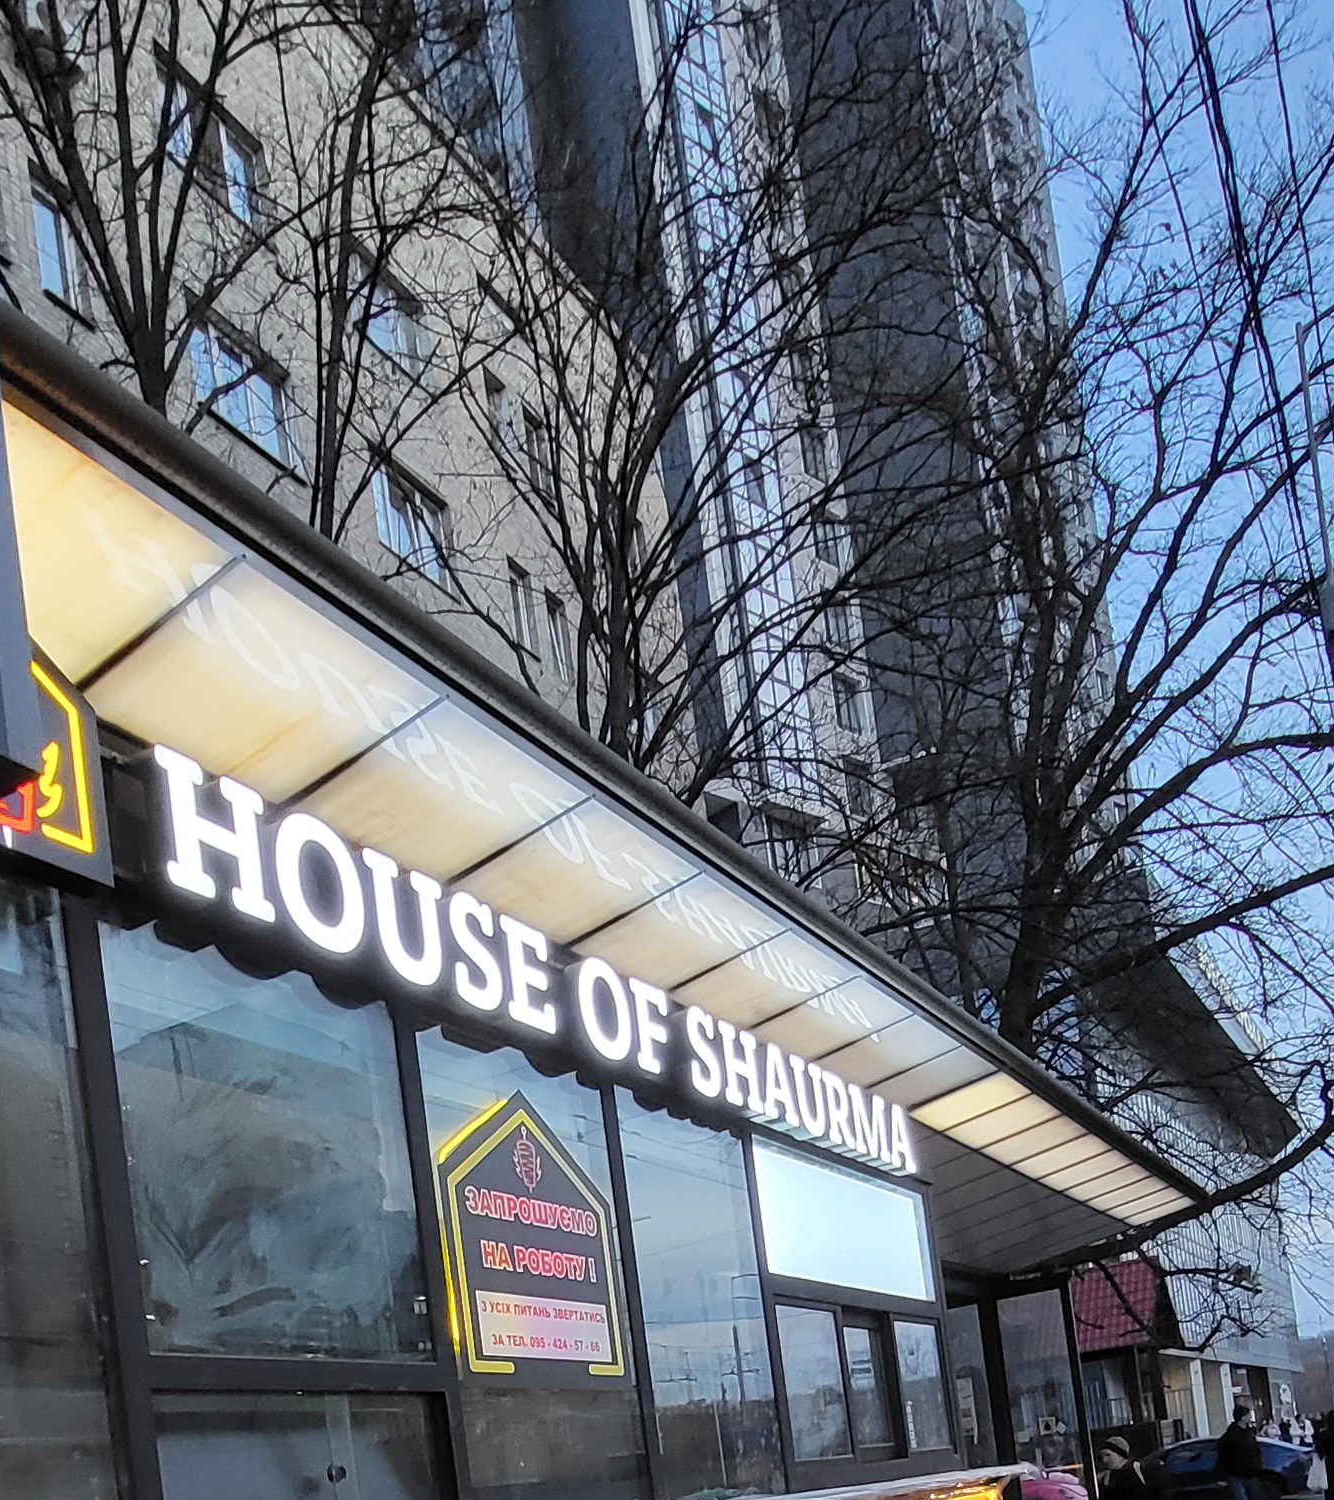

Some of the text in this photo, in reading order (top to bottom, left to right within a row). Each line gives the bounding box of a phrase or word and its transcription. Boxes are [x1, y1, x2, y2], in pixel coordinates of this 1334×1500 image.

[153, 743, 916, 1174] HOUSE OF SHAURMA
[465, 1186, 598, 1237] ЗАПРОШУЄМО
[481, 1240, 513, 1271] НА
[514, 1245, 586, 1282] РОБОТУ
[489, 1301, 511, 1315] УСІХ
[514, 1304, 551, 1319] ПИТАНЬ
[553, 1308, 606, 1324] ЗВЕРТАТИСЬ
[492, 1333, 505, 1346] ЗА
[506, 1334, 528, 1347] ТЕЛ.
